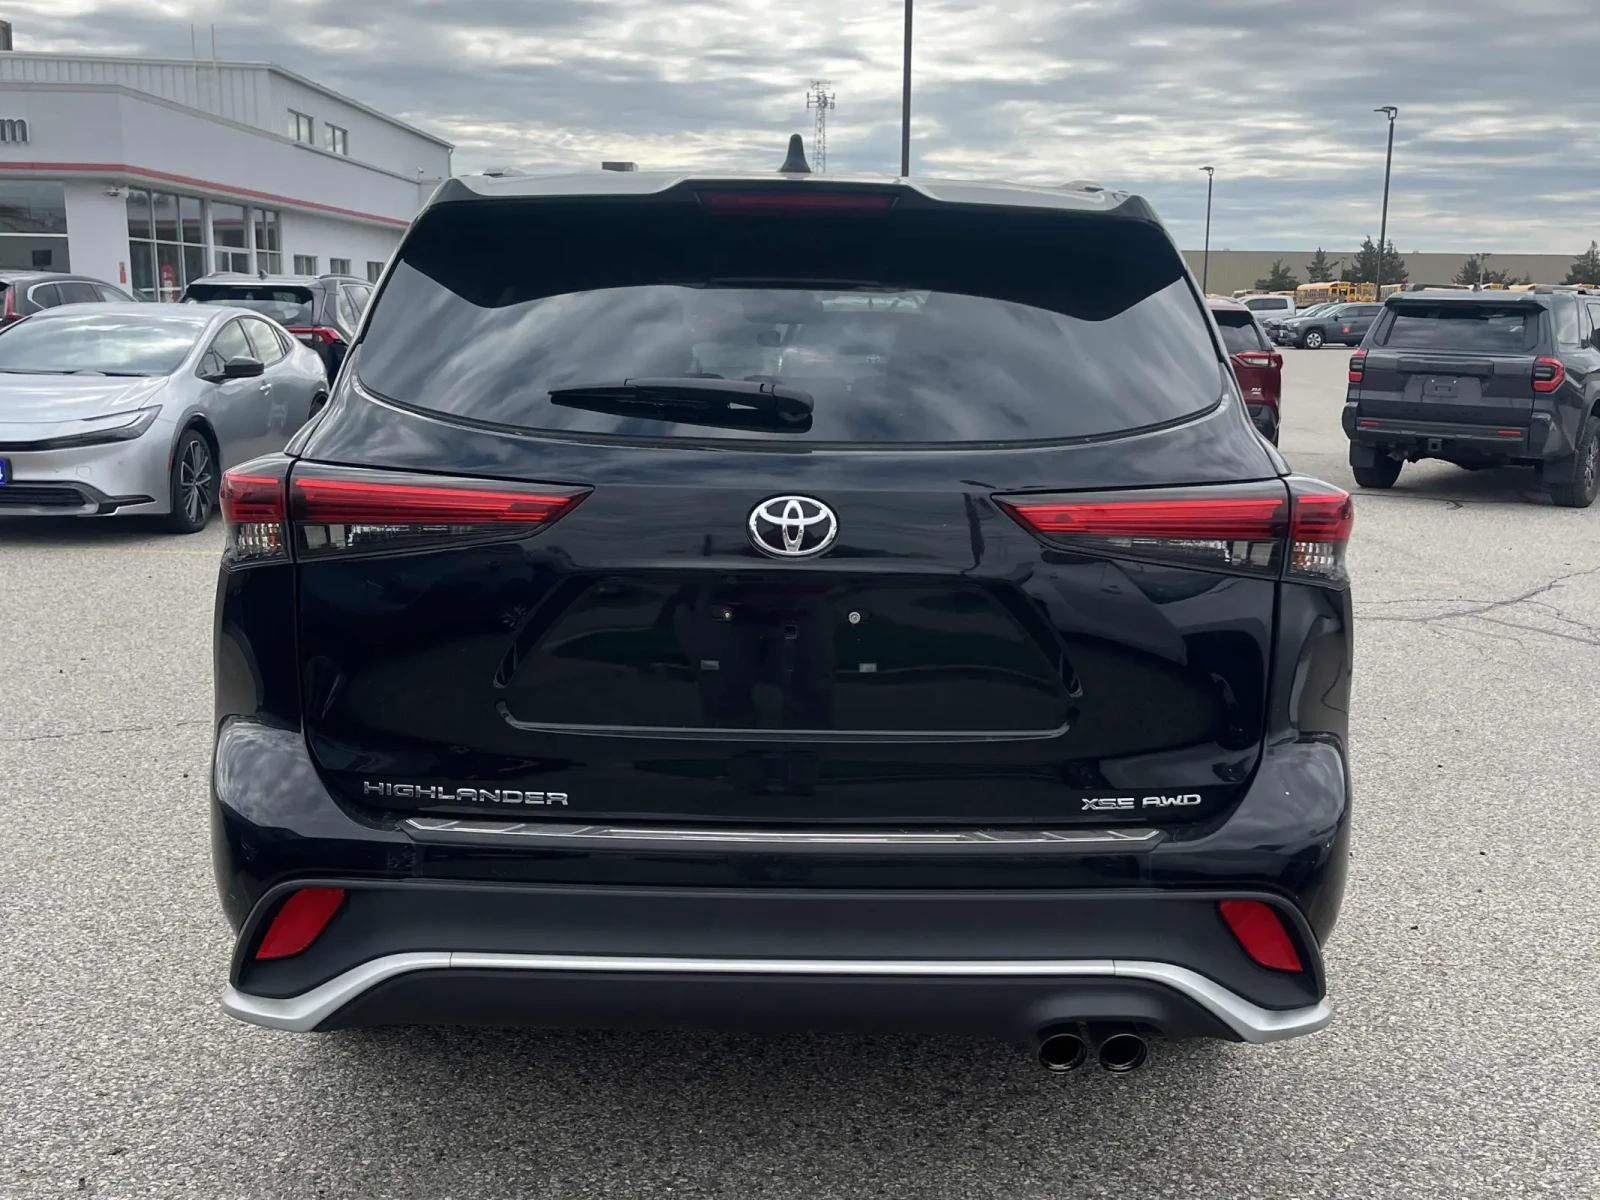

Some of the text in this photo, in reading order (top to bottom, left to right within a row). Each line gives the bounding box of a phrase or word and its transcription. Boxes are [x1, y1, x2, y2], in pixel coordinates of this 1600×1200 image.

[363, 781, 569, 806] HIGHLANDER
[1081, 793, 1202, 811] XSE AWD
